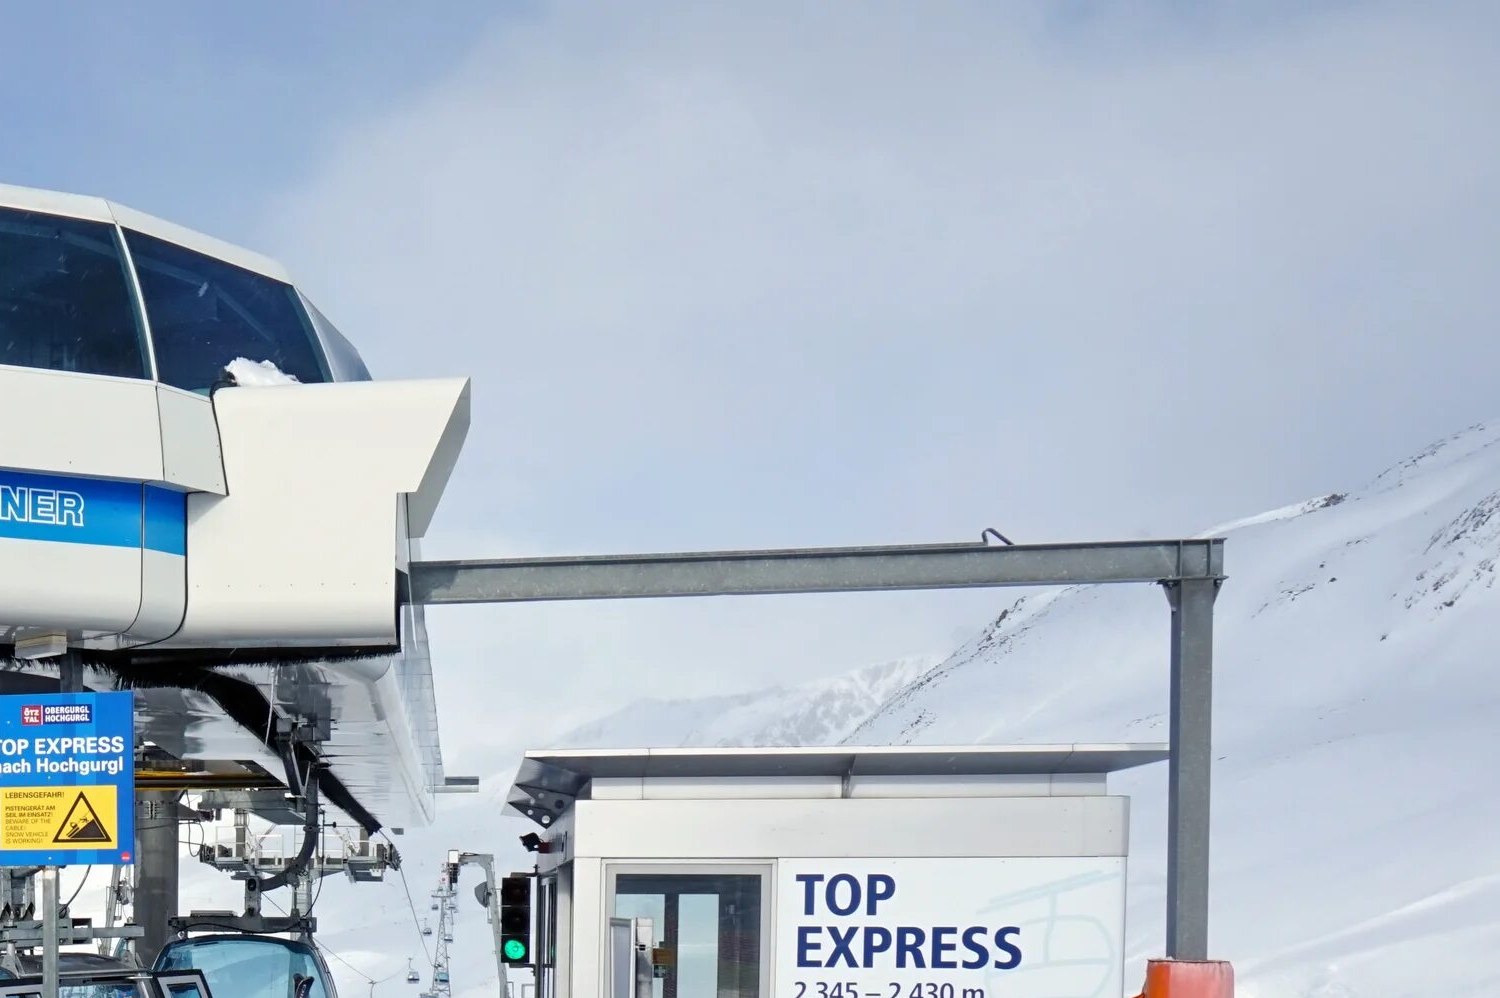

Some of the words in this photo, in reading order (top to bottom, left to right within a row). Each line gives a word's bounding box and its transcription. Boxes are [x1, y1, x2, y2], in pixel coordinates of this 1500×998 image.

[23, 707, 39, 716] ÖTZ
[44, 705, 90, 715] OBERGURGL
[45, 714, 90, 722] HOCHGURGL
[34, 736, 124, 755] EXPRESS
[36, 755, 124, 775] Hochgurgl
[5, 791, 65, 799] LEBENSGEFAHR!
[795, 873, 896, 917] TOP
[796, 926, 1023, 970] EXPRESS
